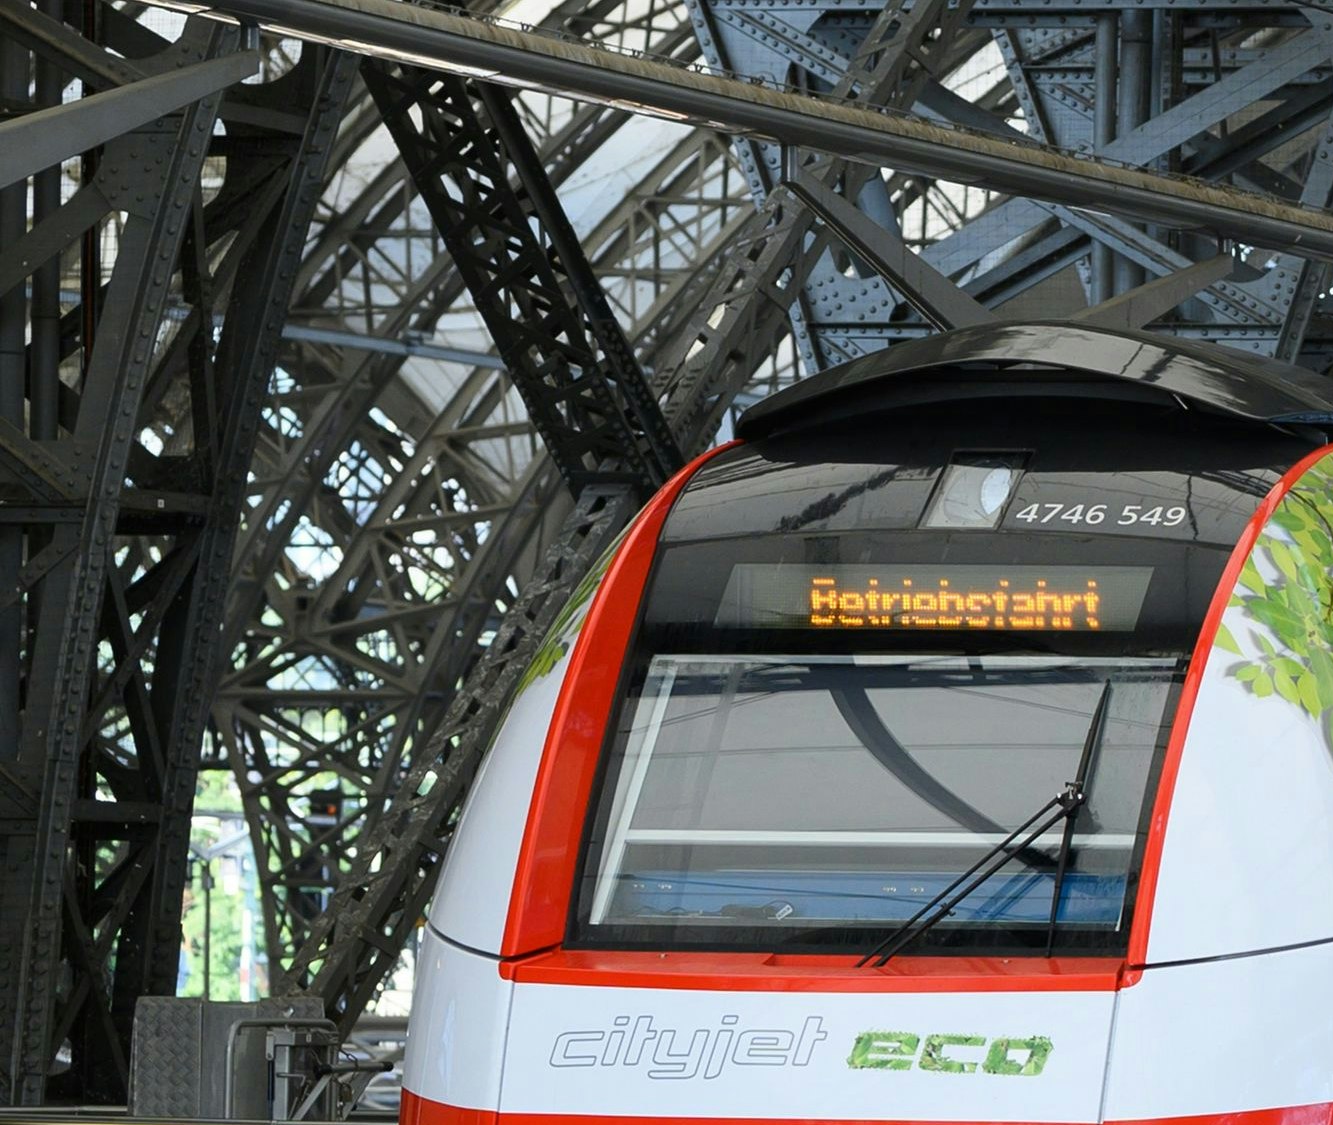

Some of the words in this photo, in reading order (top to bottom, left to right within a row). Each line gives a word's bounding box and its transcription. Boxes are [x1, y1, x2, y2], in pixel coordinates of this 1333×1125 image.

[1016, 503, 1107, 525] 4746
[1117, 505, 1187, 527] 549
[810, 577, 1101, 629] Betriebsfahrt
[549, 1014, 828, 1081] cityjet
[846, 1027, 1055, 1078] eco
